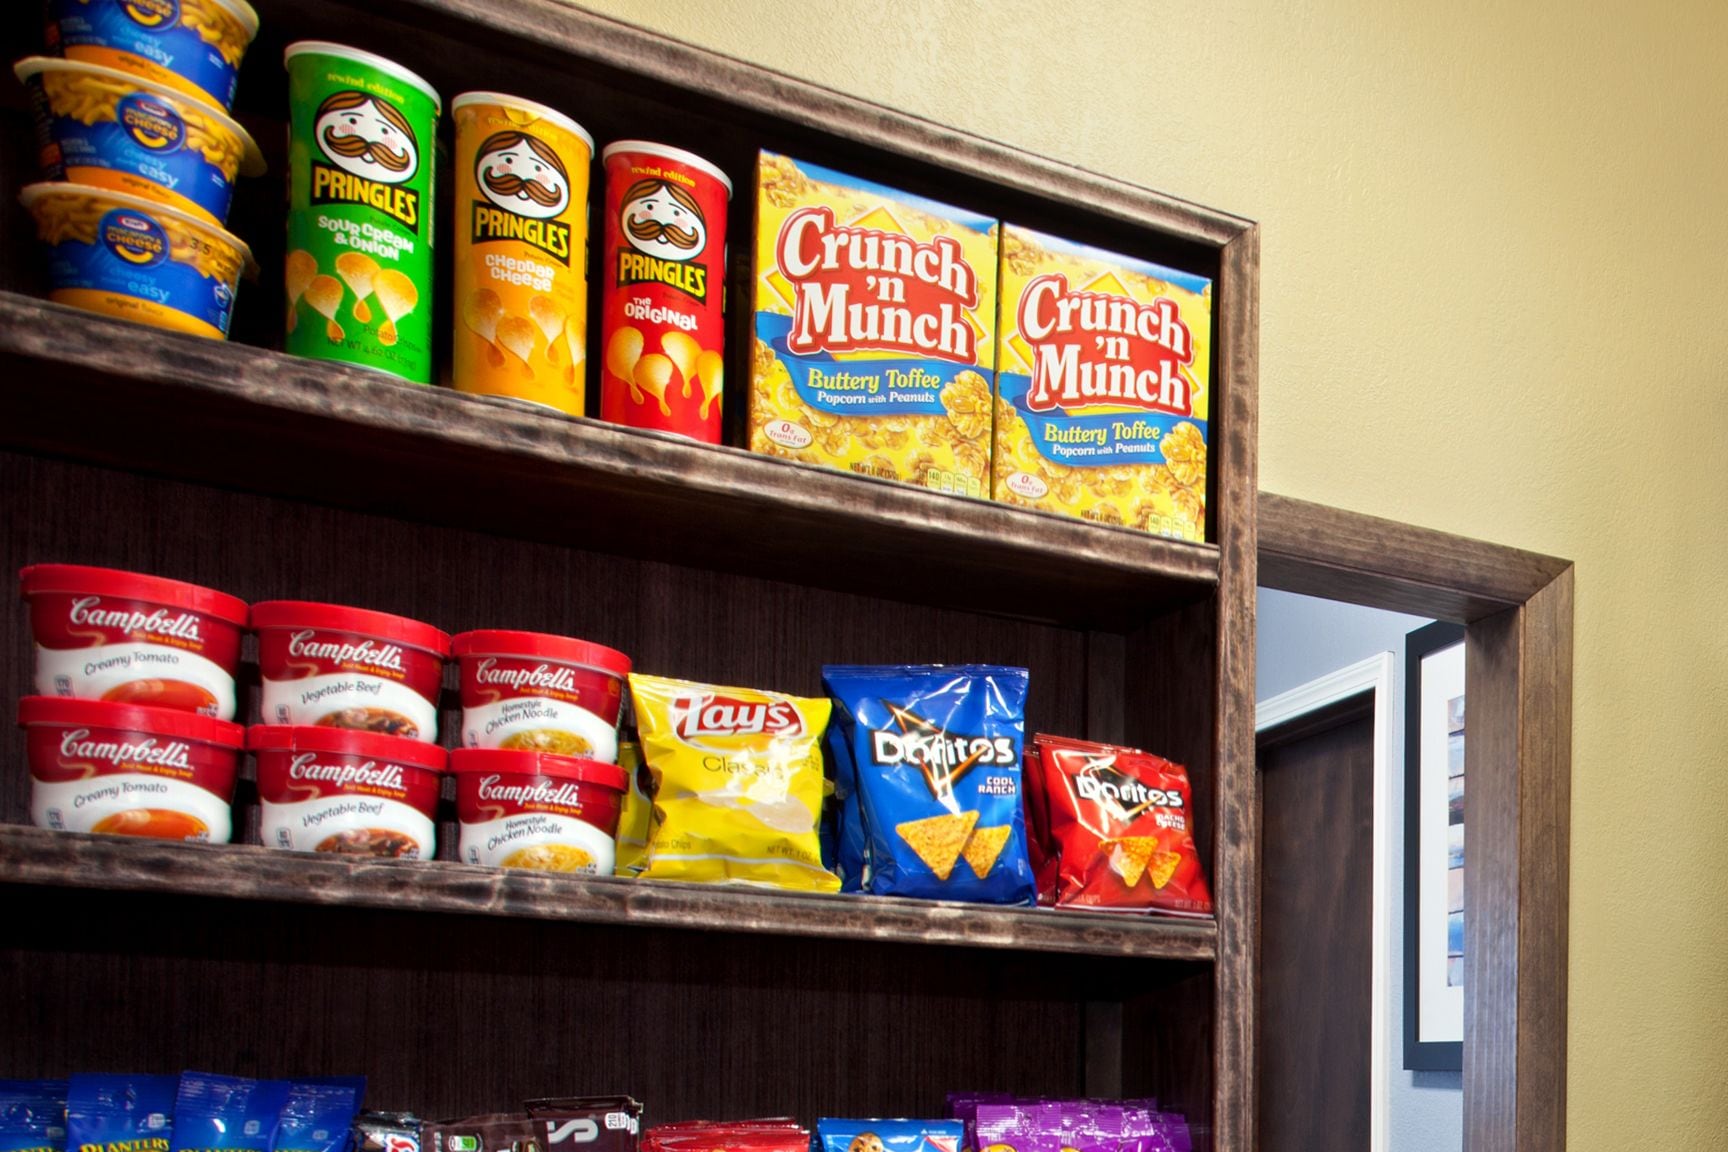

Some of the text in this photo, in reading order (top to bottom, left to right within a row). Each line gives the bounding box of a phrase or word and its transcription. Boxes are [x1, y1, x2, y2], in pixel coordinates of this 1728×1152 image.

[327, 72, 404, 104] rewind edition
[138, 160, 179, 188] easy
[631, 166, 695, 187] rewind edition
[314, 165, 417, 225] PRINGLES
[475, 207, 570, 258] PRINGLES
[783, 212, 969, 299] Crunch
[619, 252, 706, 297] PRINGLES
[127, 277, 170, 303] easy
[796, 282, 969, 358] Munch
[1022, 279, 1186, 357] Crunch
[807, 367, 941, 394] Buttery Toffee
[1034, 343, 1186, 410] Munch
[817, 390, 935, 405] Popcorn with Peanuts
[1044, 421, 1161, 446] Buttery Toffee
[1052, 442, 1156, 459] Popcorn Peanuts
[84, 651, 180, 676] Creamy Tomato
[301, 680, 383, 704] Vegetable Beef
[501, 700, 542, 714] Homestyle
[485, 707, 559, 735] Chicken Noodle
[873, 730, 1015, 765] Doritos
[978, 785, 1016, 795] RANCH
[986, 776, 1015, 786] COOL
[1076, 774, 1184, 808] Doritos
[74, 782, 167, 808] Creamy Tomato
[302, 803, 384, 828] Vegetable Beef
[505, 816, 547, 830] Homestyle
[487, 823, 562, 851] Chicken Noodle
